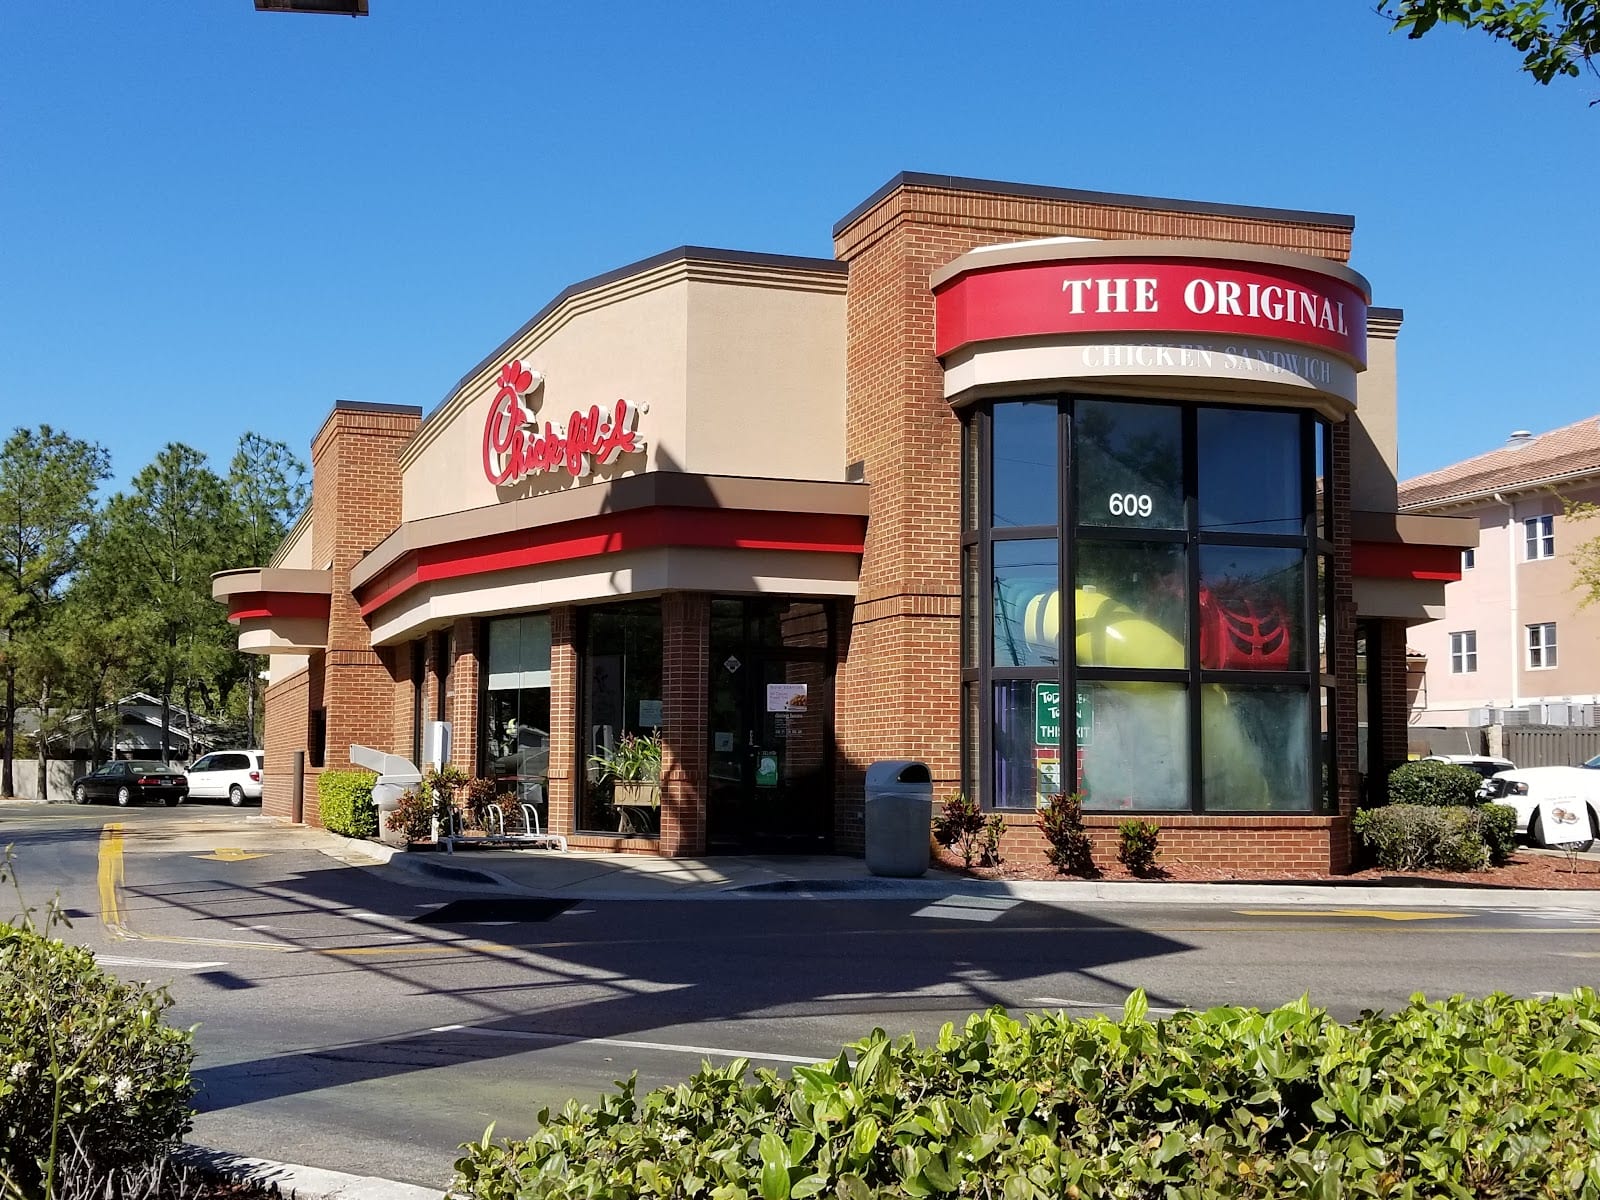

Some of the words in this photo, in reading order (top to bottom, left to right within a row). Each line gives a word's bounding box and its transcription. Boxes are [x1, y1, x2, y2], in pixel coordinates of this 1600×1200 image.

[1062, 278, 1158, 314] THE
[1184, 279, 1349, 336] ORIGINAL
[1081, 344, 1213, 369] CHICKEN
[1224, 346, 1331, 384] SANDWICH
[483, 360, 637, 486] Chick-fil-A
[1109, 493, 1152, 517] 609
[1039, 691, 1090, 704] TODER
[1048, 707, 1082, 719] TON
[1076, 727, 1090, 738] XIT
